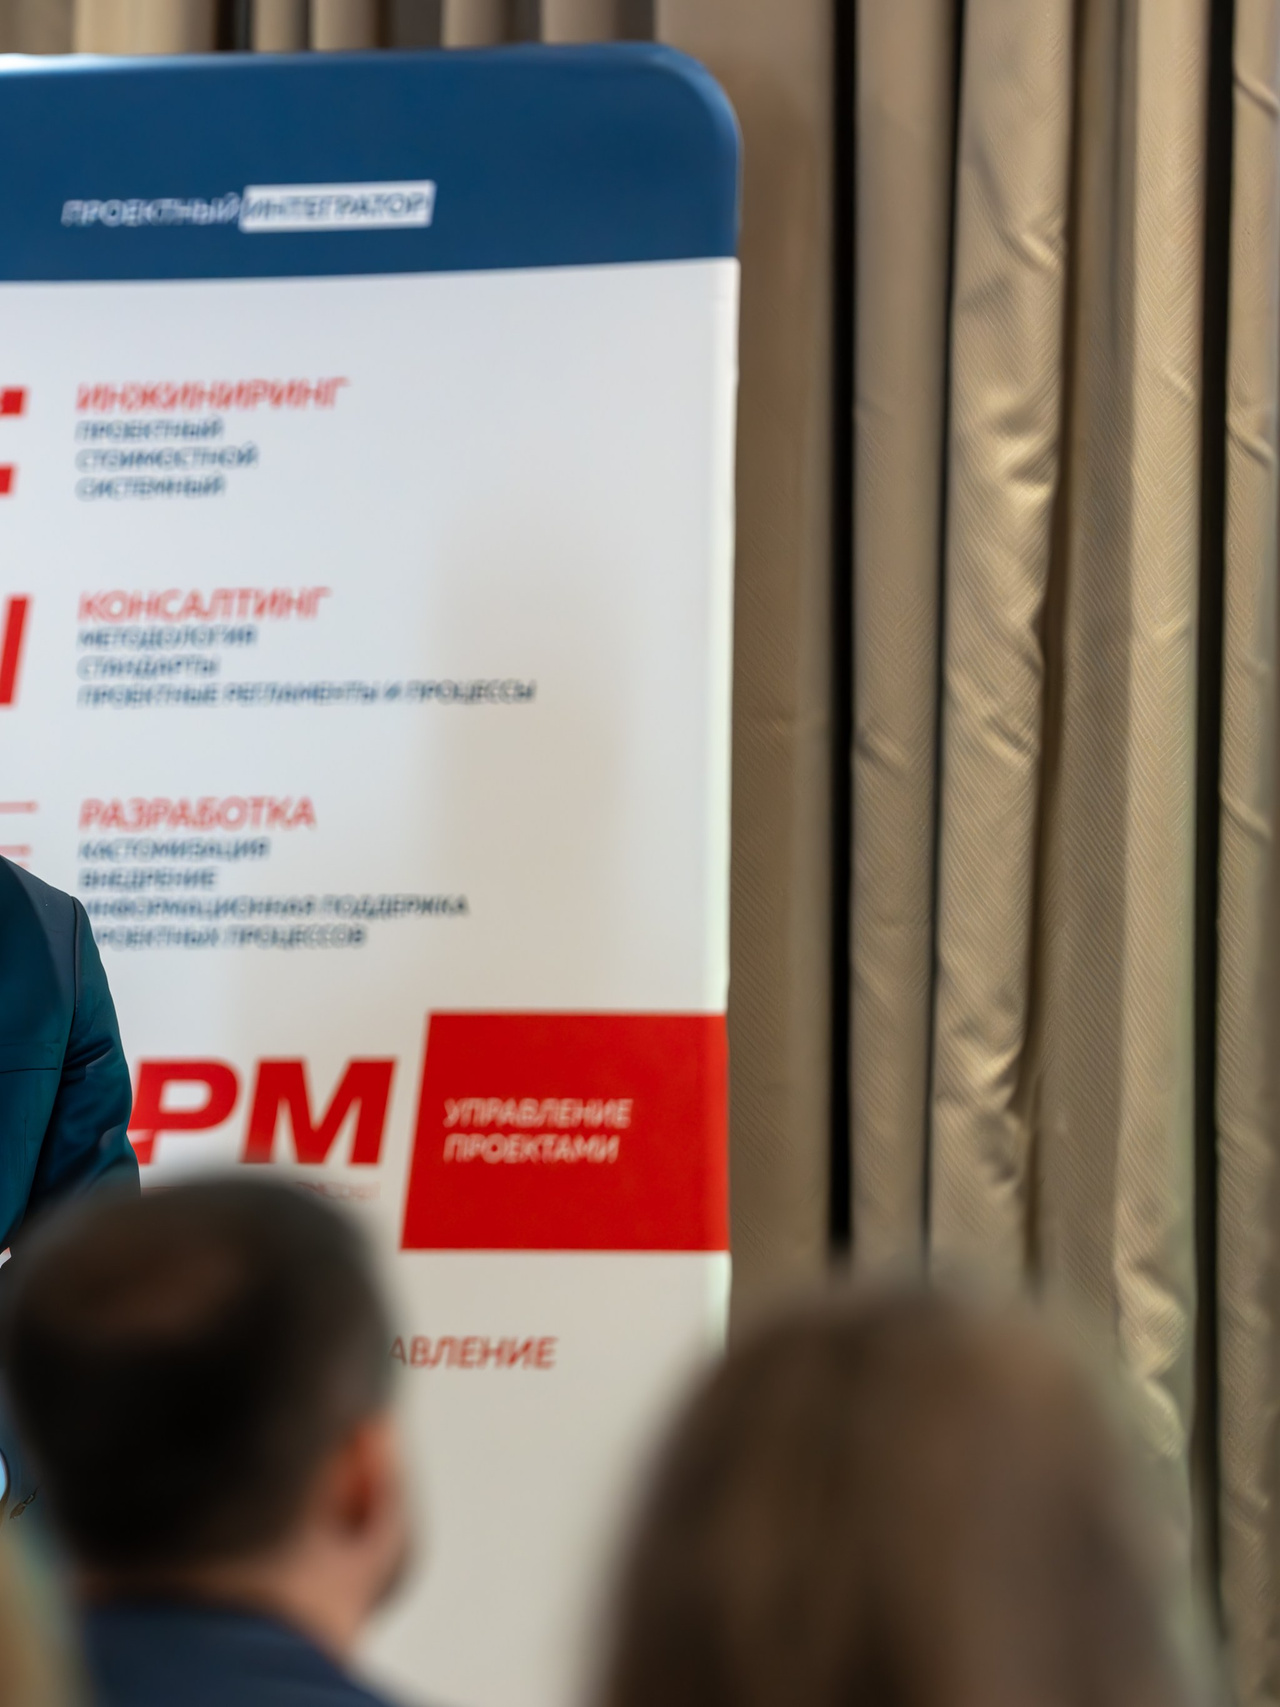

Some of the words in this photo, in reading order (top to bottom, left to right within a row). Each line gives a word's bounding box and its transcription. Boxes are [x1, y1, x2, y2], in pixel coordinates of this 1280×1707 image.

[61, 192, 240, 227] ПРОЕКТНЫЙ
[245, 192, 427, 223] ИНТЕГРАТОР
[76, 377, 348, 412] ИНЖИНИРИНГ
[77, 587, 331, 622] КОНСАЛТИНГ
[77, 796, 317, 830] РАЗРАБОТКА
[92, 926, 220, 950] РОЕКТНЫХ
[442, 1098, 633, 1128] УПРАВЛЕНИЕ
[442, 1133, 619, 1164] ПРОЕКТАМИ
[389, 1335, 558, 1369] АВЛЕНИЕ
